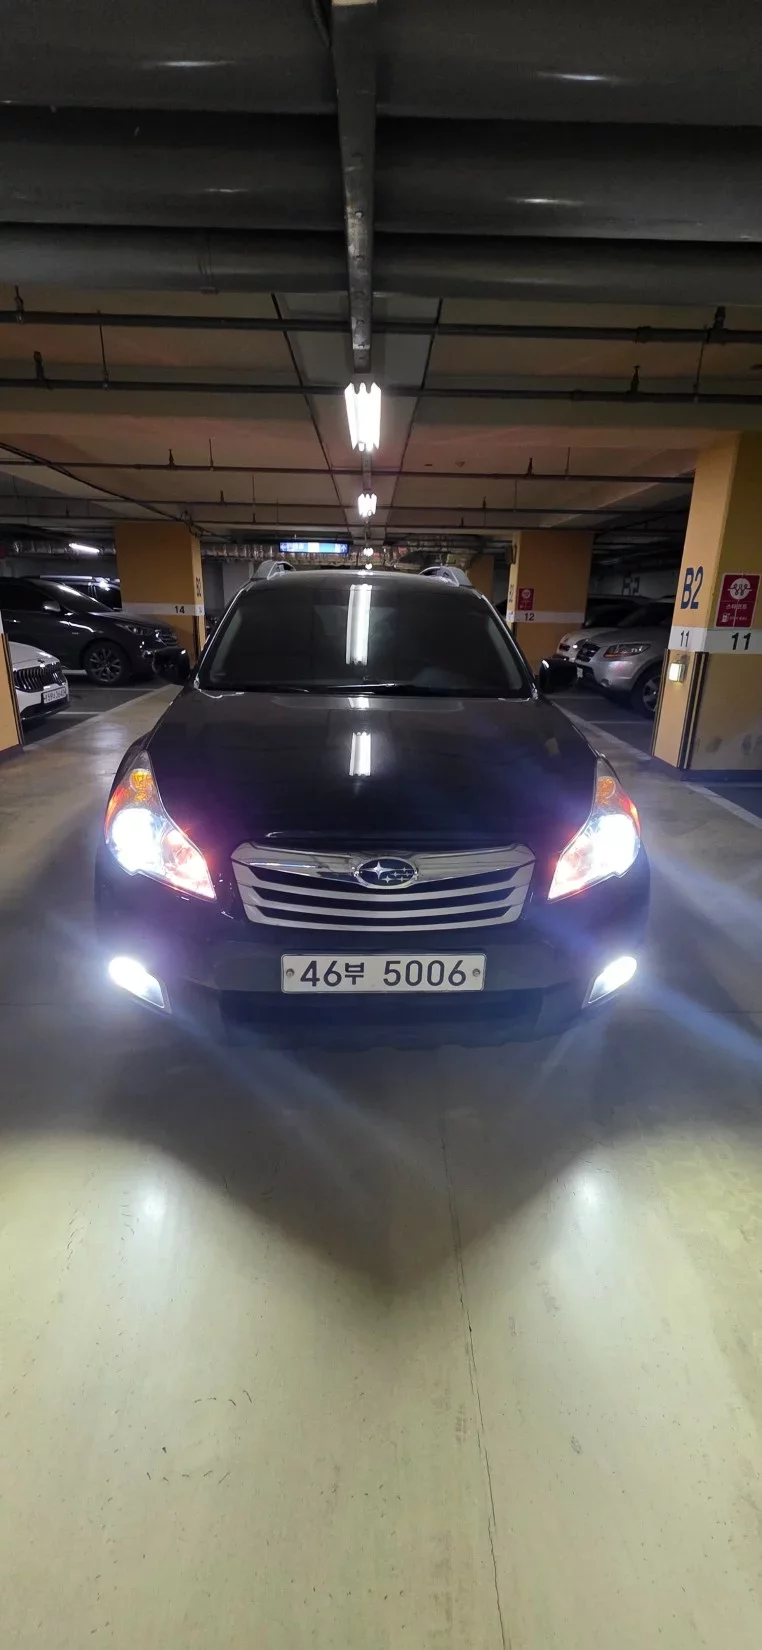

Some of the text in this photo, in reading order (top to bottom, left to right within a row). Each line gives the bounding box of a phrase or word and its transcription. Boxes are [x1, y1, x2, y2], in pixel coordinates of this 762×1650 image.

[681, 566, 703, 609] B2
[174, 605, 185, 614] 14
[524, 612, 535, 622] 12
[680, 630, 690, 647] 11
[732, 632, 751, 650] 11
[300, 960, 467, 987] 46부 5006
